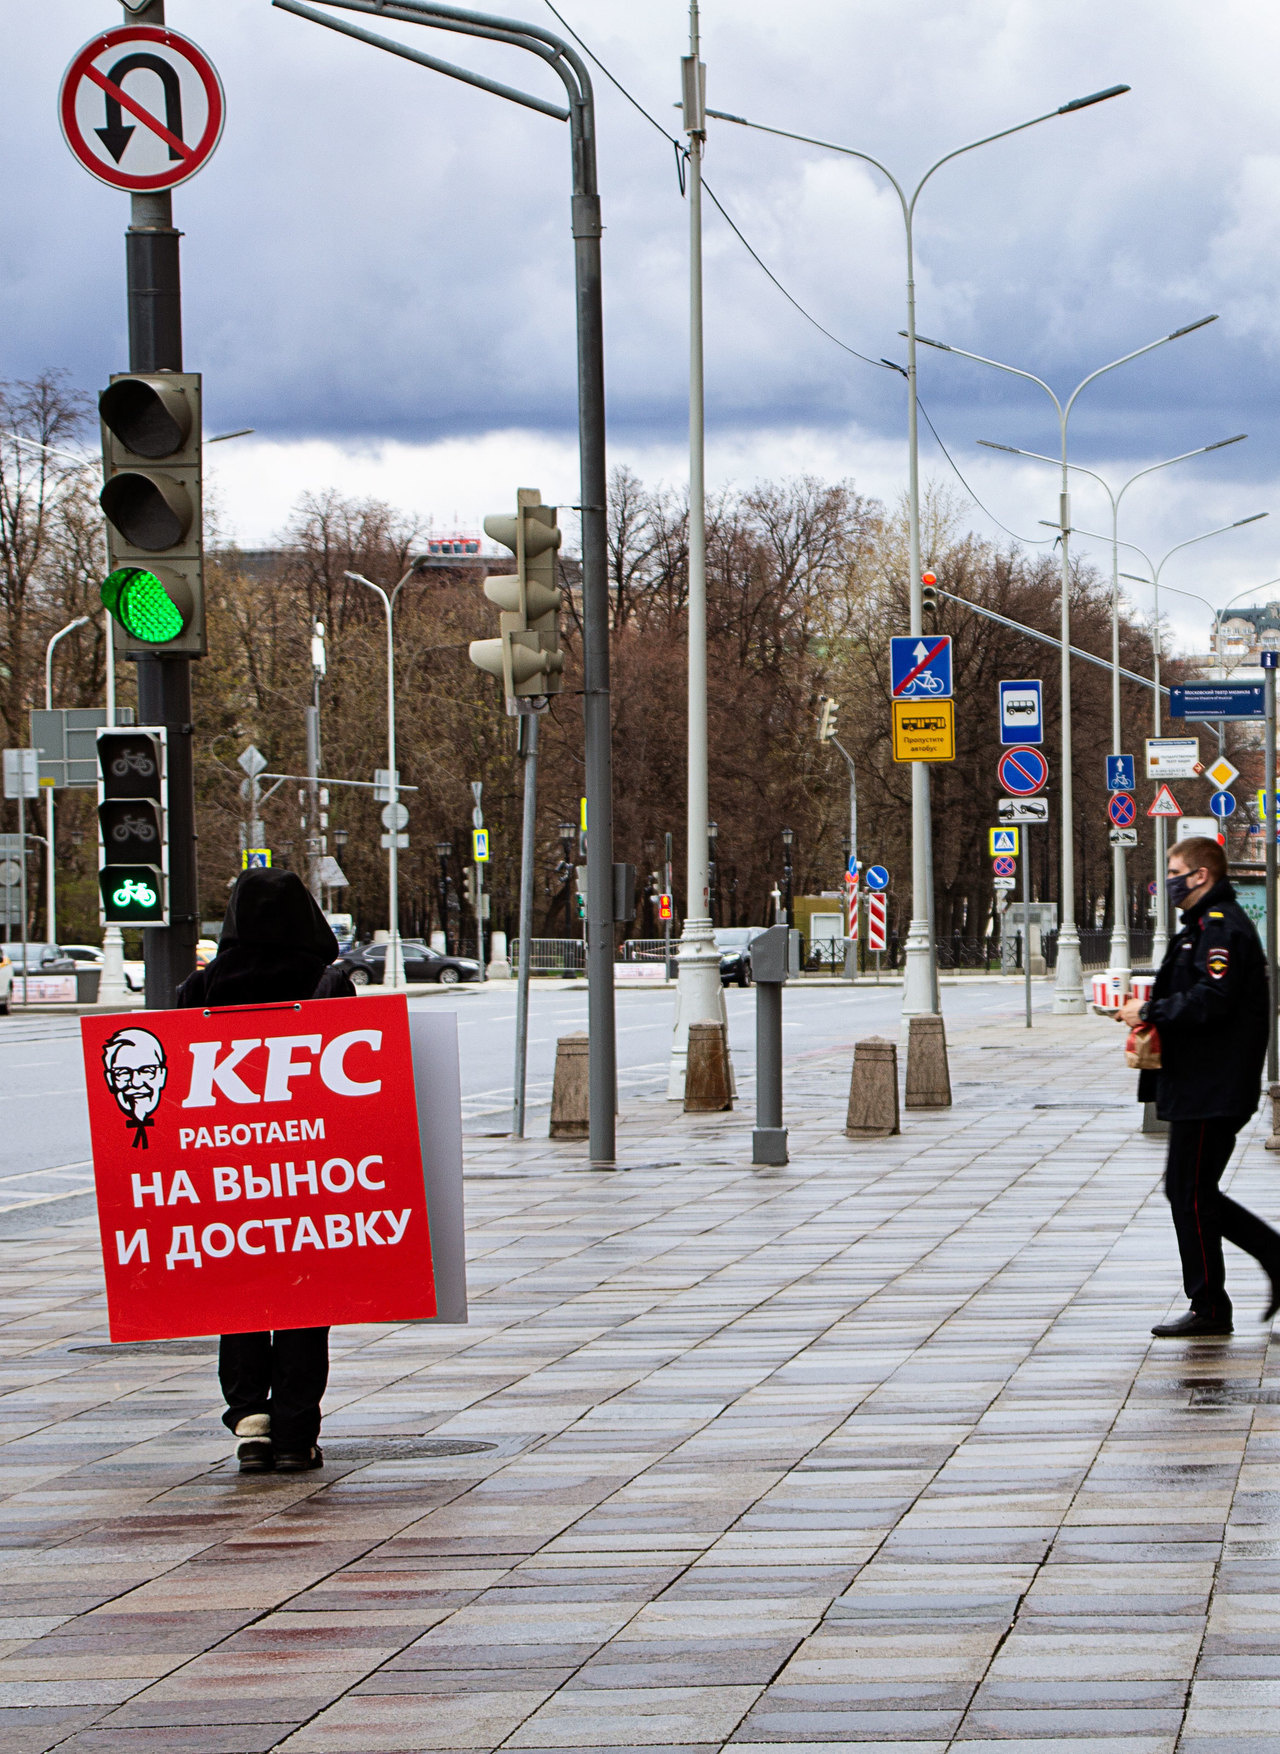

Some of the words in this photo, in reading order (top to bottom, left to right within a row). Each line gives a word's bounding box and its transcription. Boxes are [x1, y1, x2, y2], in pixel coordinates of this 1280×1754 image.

[903, 736, 945, 744] Пропустите
[182, 1030, 382, 1108] KFC
[179, 1118, 325, 1149] РАБОТАЕМ
[131, 1170, 200, 1208] НА
[213, 1155, 385, 1202] ВЫНОС
[115, 1229, 150, 1265] И
[165, 1208, 412, 1271] ДОСТАВКУ
